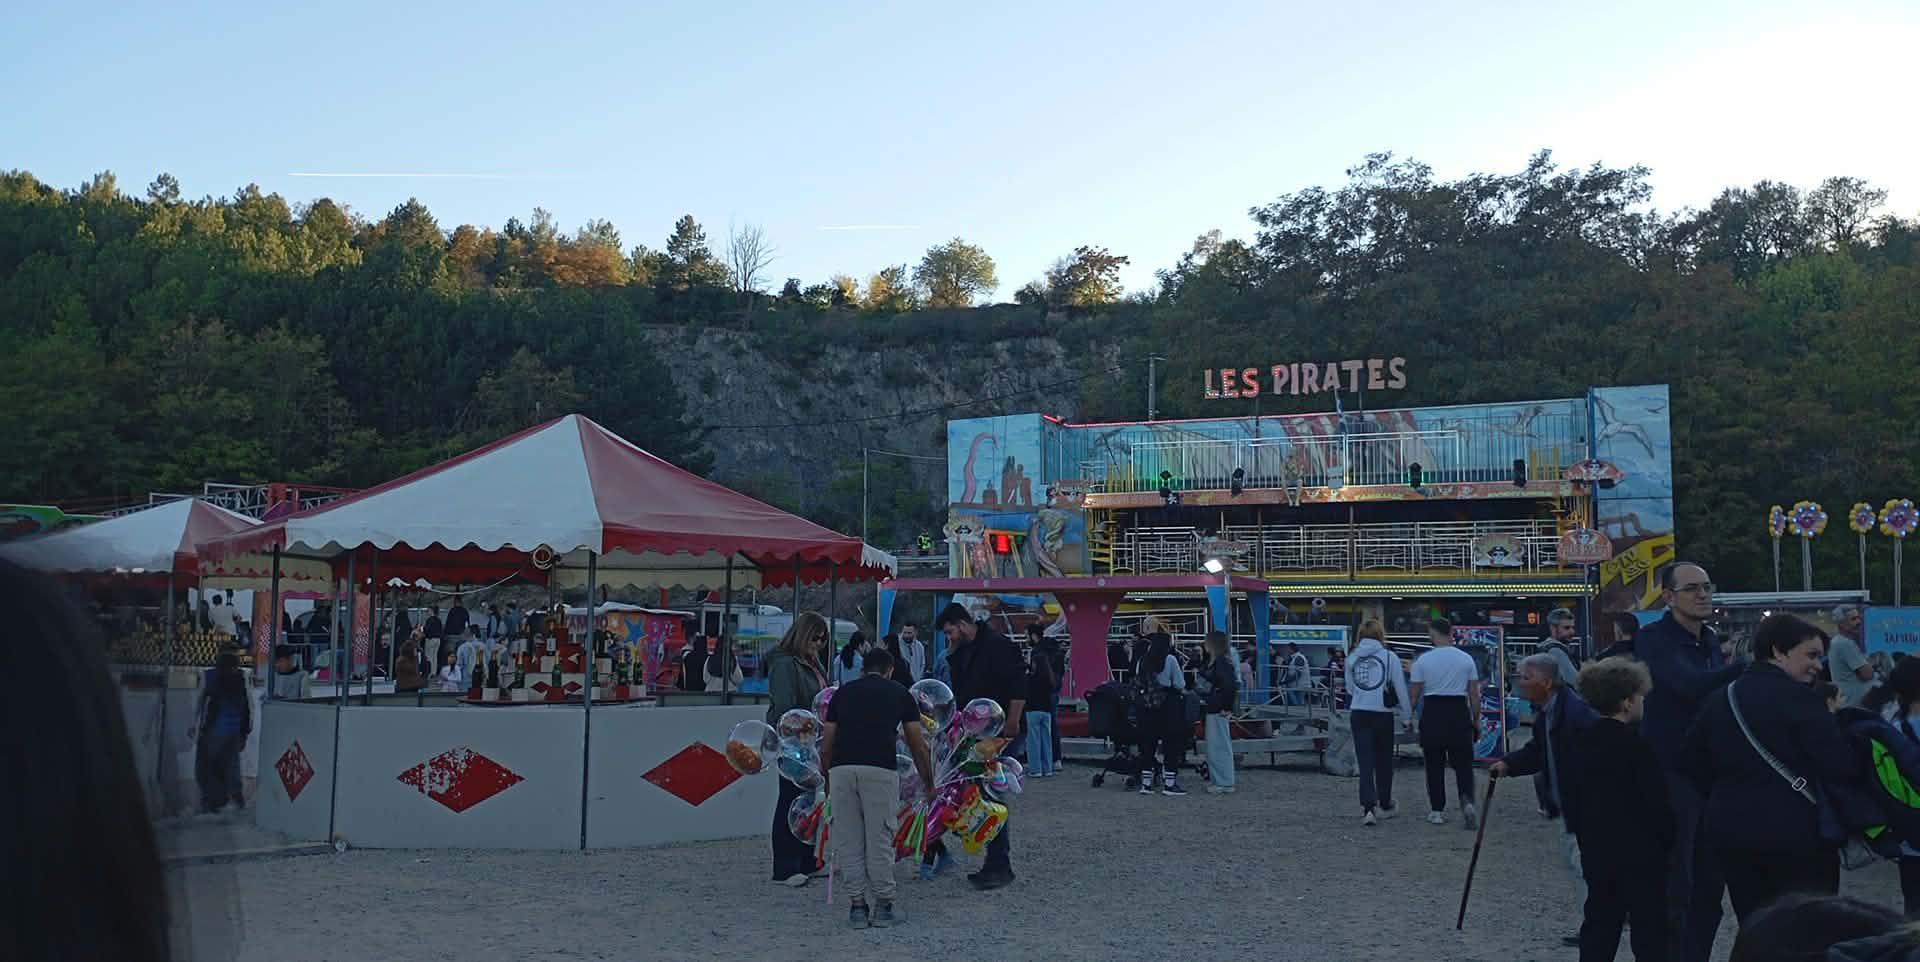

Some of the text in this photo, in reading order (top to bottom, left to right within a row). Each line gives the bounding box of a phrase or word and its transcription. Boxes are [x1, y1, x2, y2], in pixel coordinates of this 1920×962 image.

[1204, 356, 1408, 399] LES PIRATES
[1279, 630, 1329, 639] CASSA
